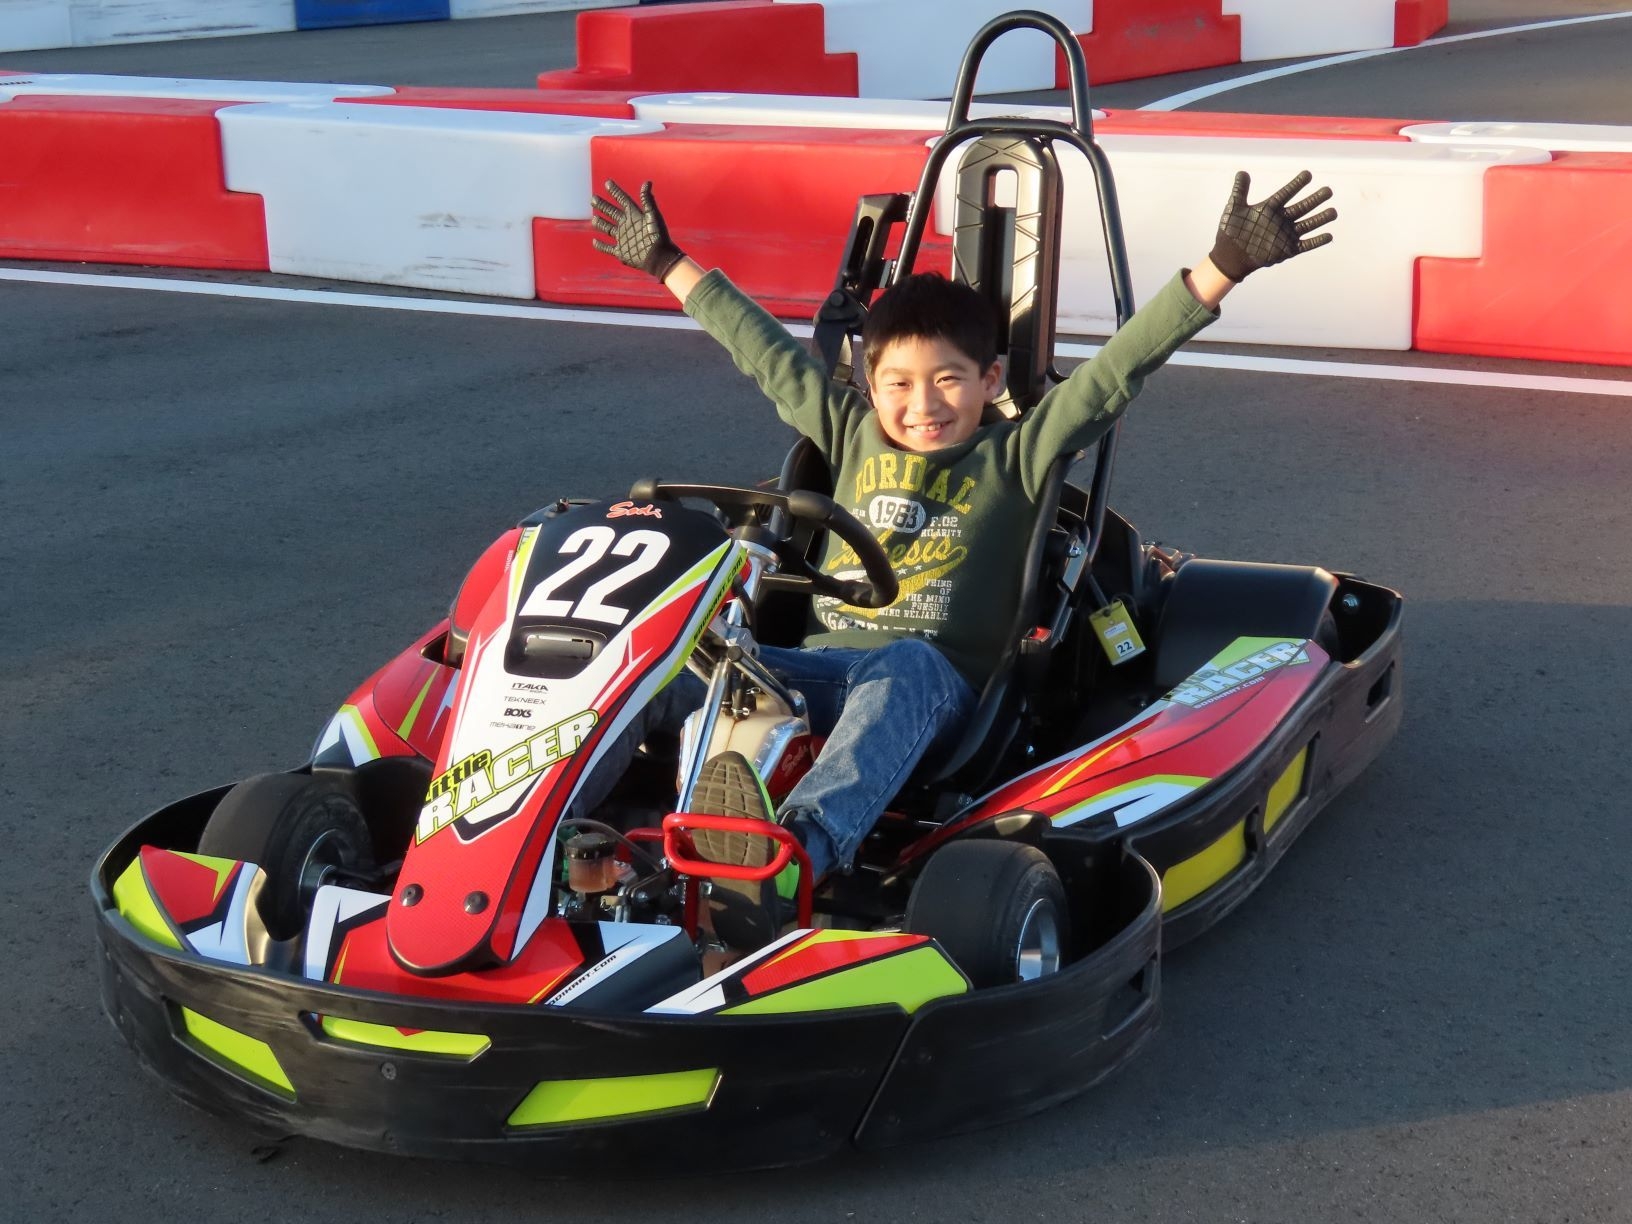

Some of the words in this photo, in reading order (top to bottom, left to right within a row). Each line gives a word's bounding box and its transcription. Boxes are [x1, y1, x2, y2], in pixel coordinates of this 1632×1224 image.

[518, 525, 671, 626] 22
[1117, 641, 1133, 654] 22
[1172, 643, 1310, 706] RACER
[416, 710, 599, 845] RACER
